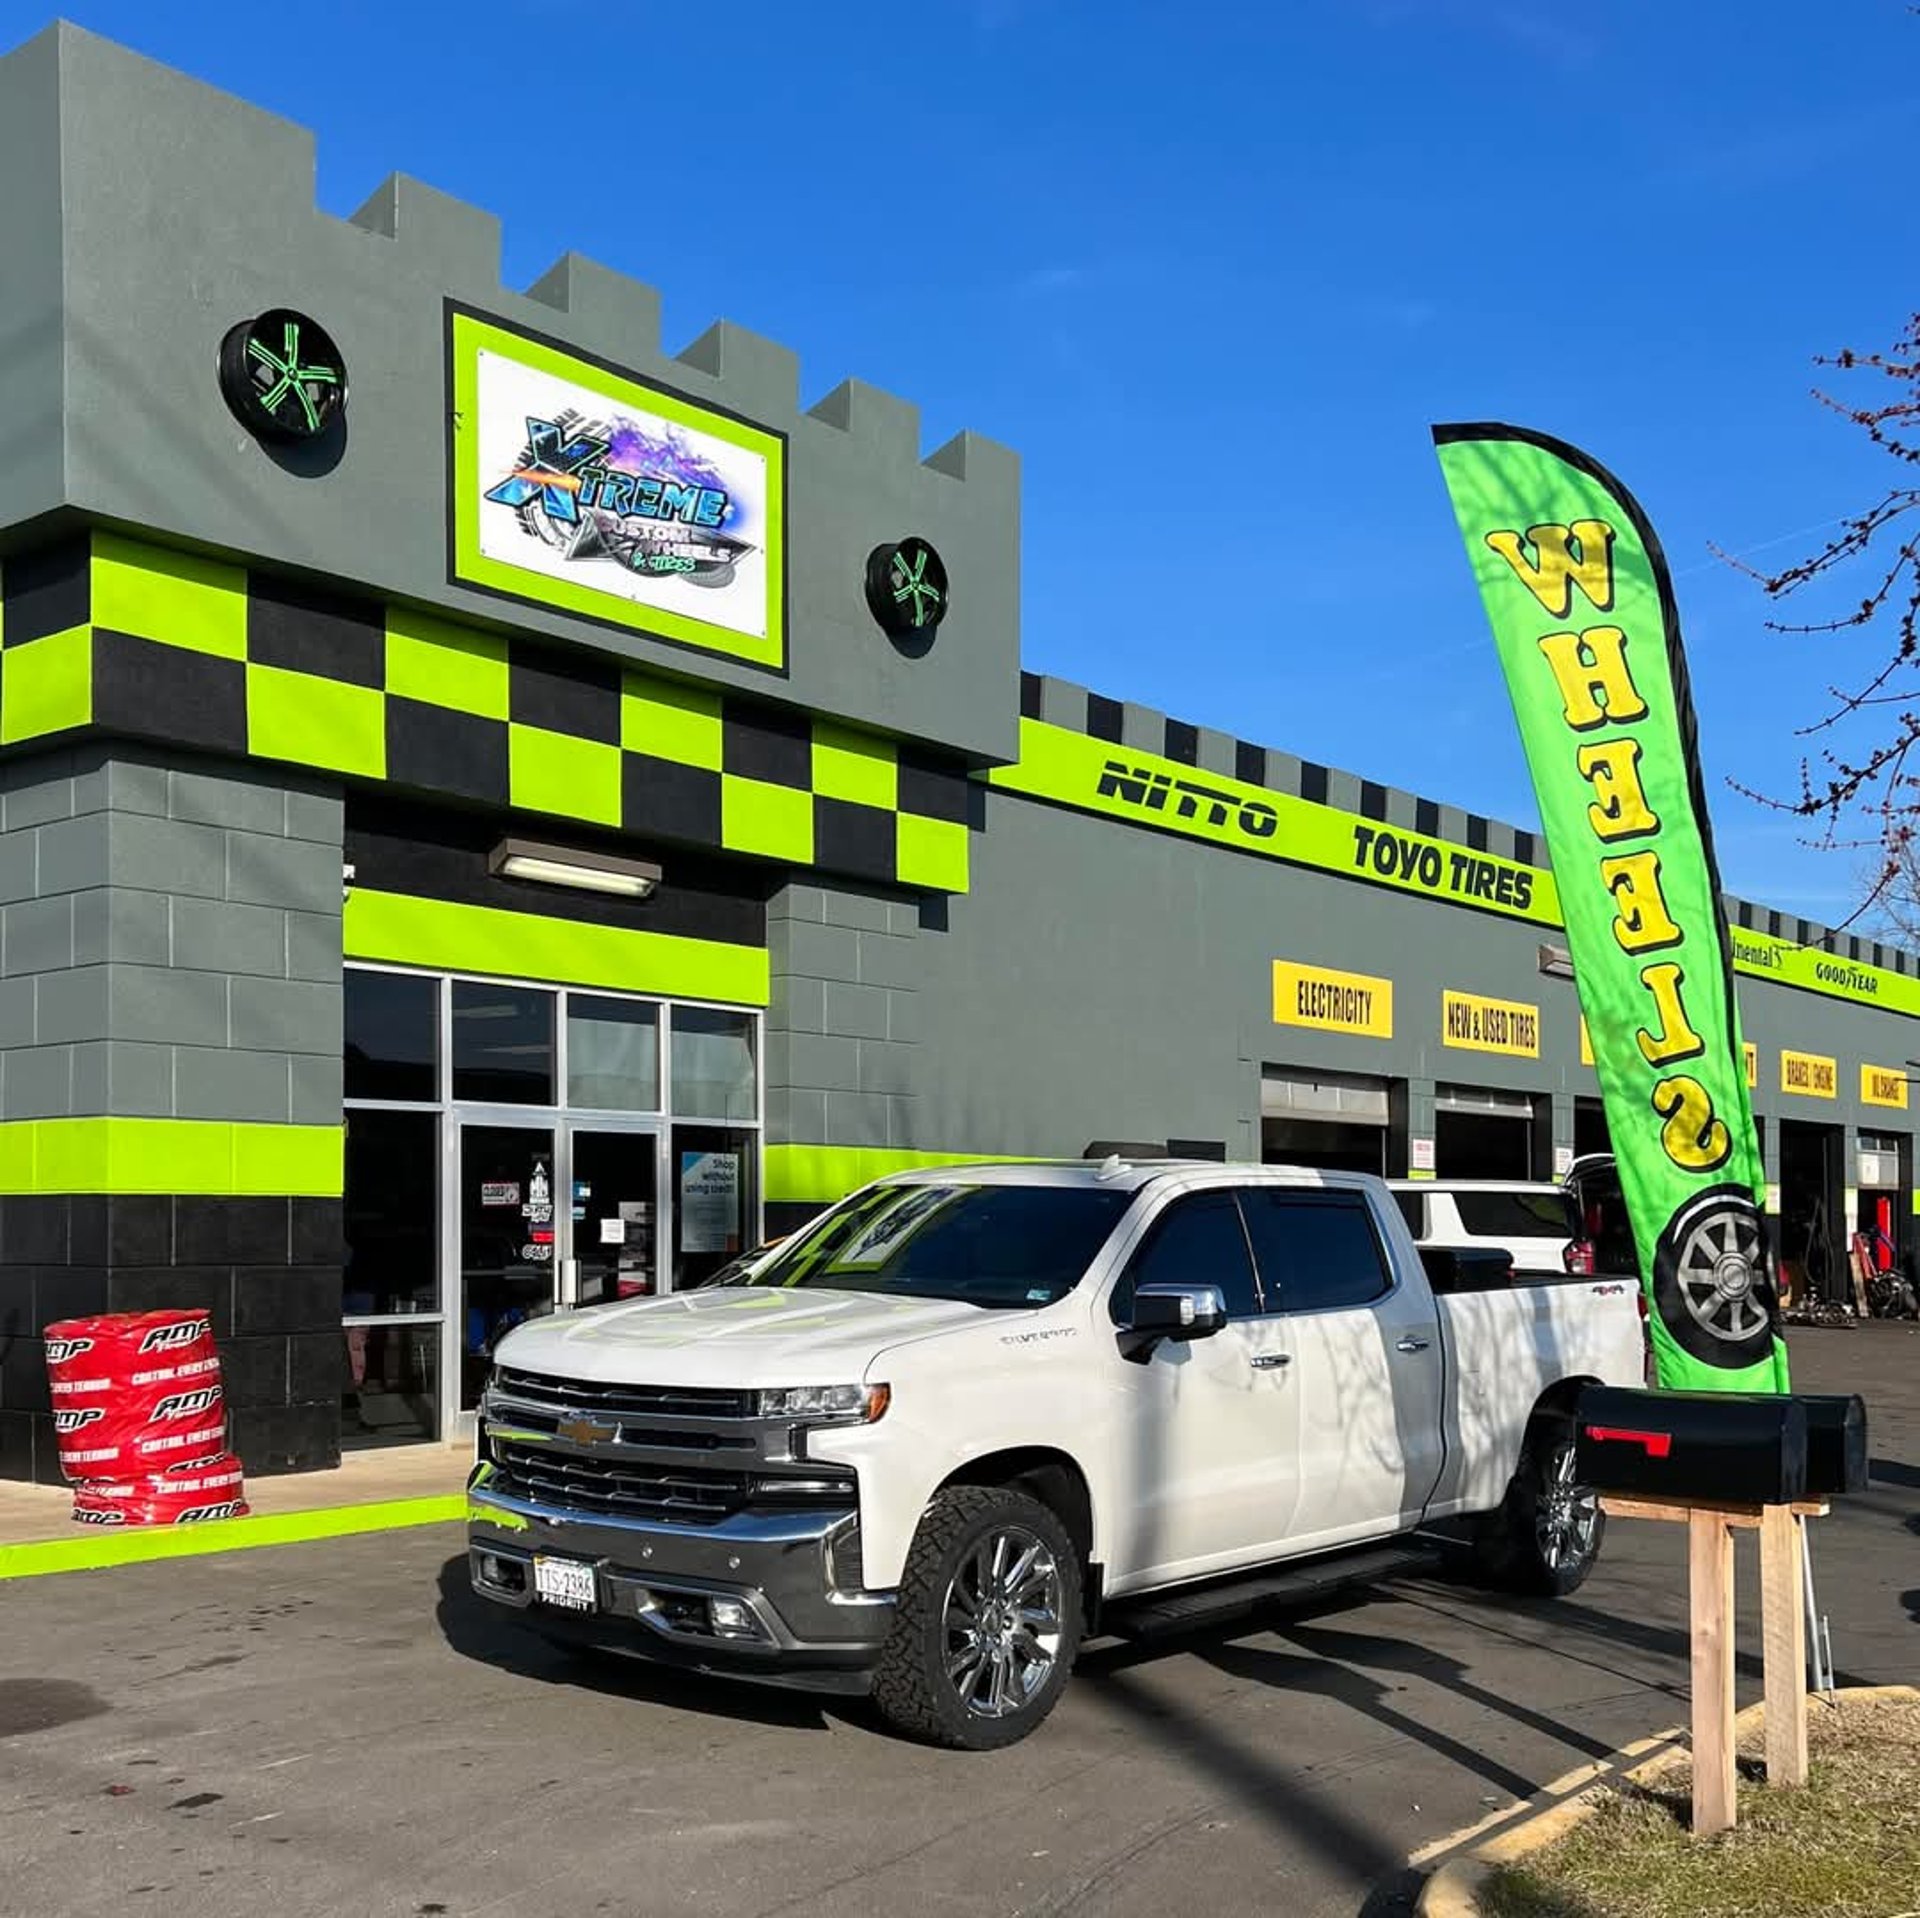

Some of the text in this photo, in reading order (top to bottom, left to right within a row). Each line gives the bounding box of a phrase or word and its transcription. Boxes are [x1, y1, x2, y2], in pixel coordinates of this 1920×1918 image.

[484, 415, 729, 528] XTREME
[651, 554, 696, 572] TIRES
[1097, 760, 1278, 838] NITTO
[1355, 825, 1534, 909] TOYO TIRES
[1298, 980, 1372, 1025] ELECTRICITY
[1448, 1002, 1536, 1050] NEW & USED TIRES
[149, 1385, 223, 1422] AMP
